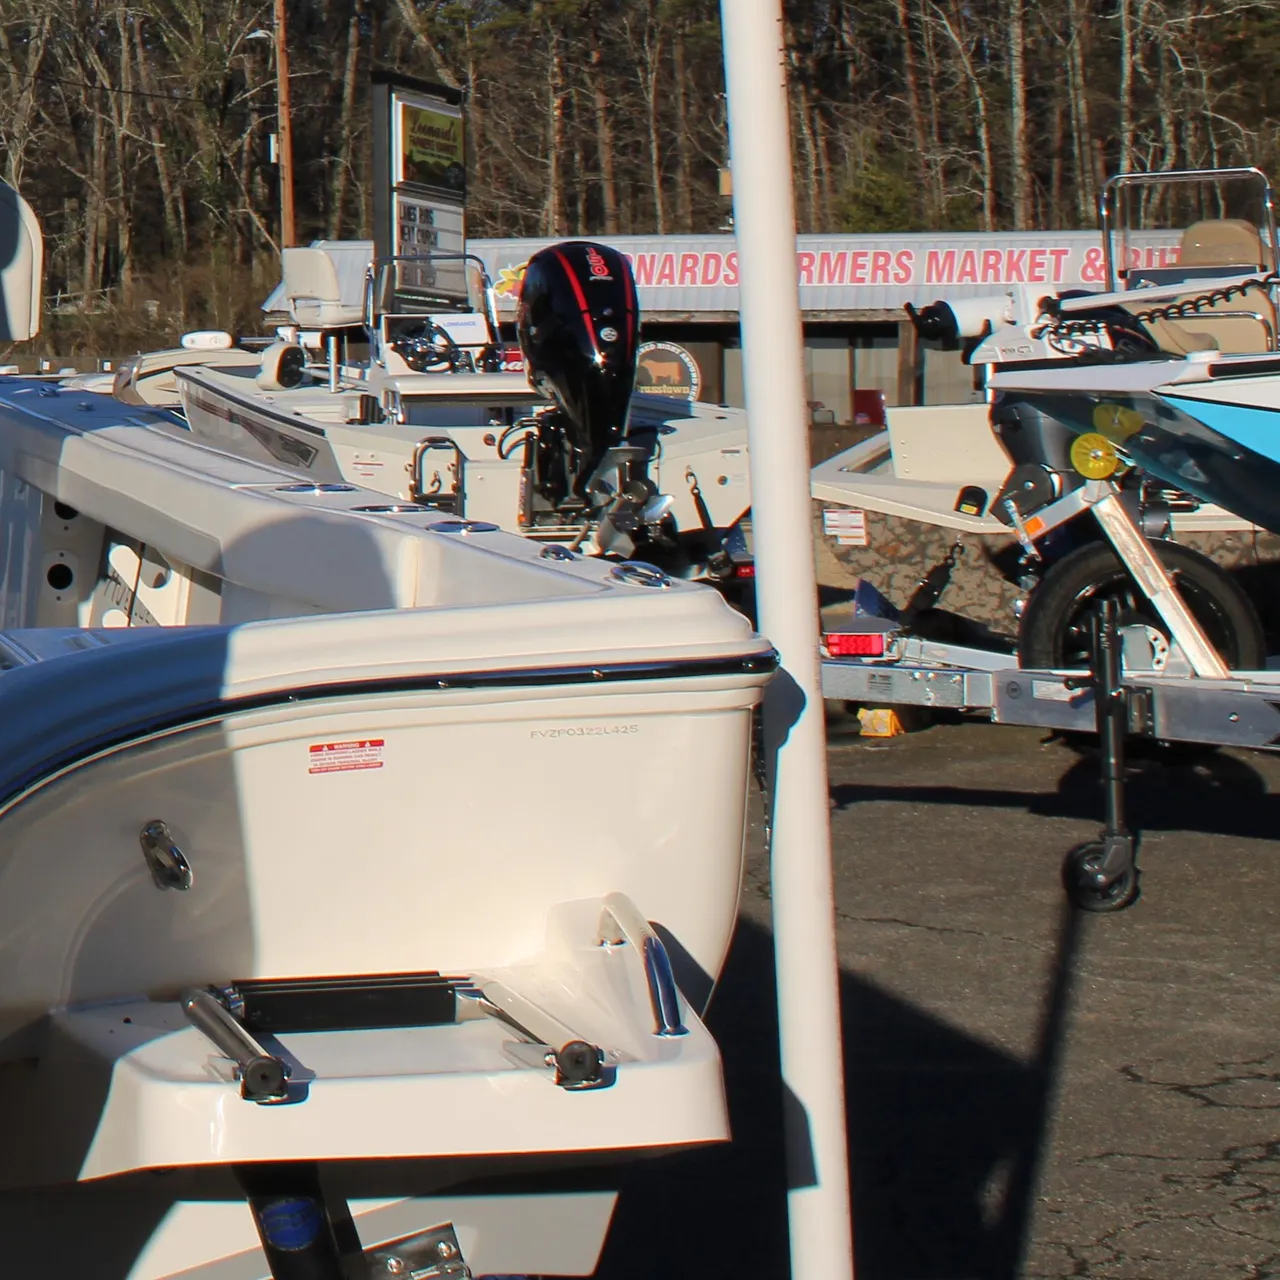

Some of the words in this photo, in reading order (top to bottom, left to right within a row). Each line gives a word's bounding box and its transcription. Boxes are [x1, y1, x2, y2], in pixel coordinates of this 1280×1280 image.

[627, 252, 739, 286] NARDS
[797, 249, 914, 286] RMERS
[925, 248, 1069, 284] MARKET
[637, 383, 690, 394] rasstown
